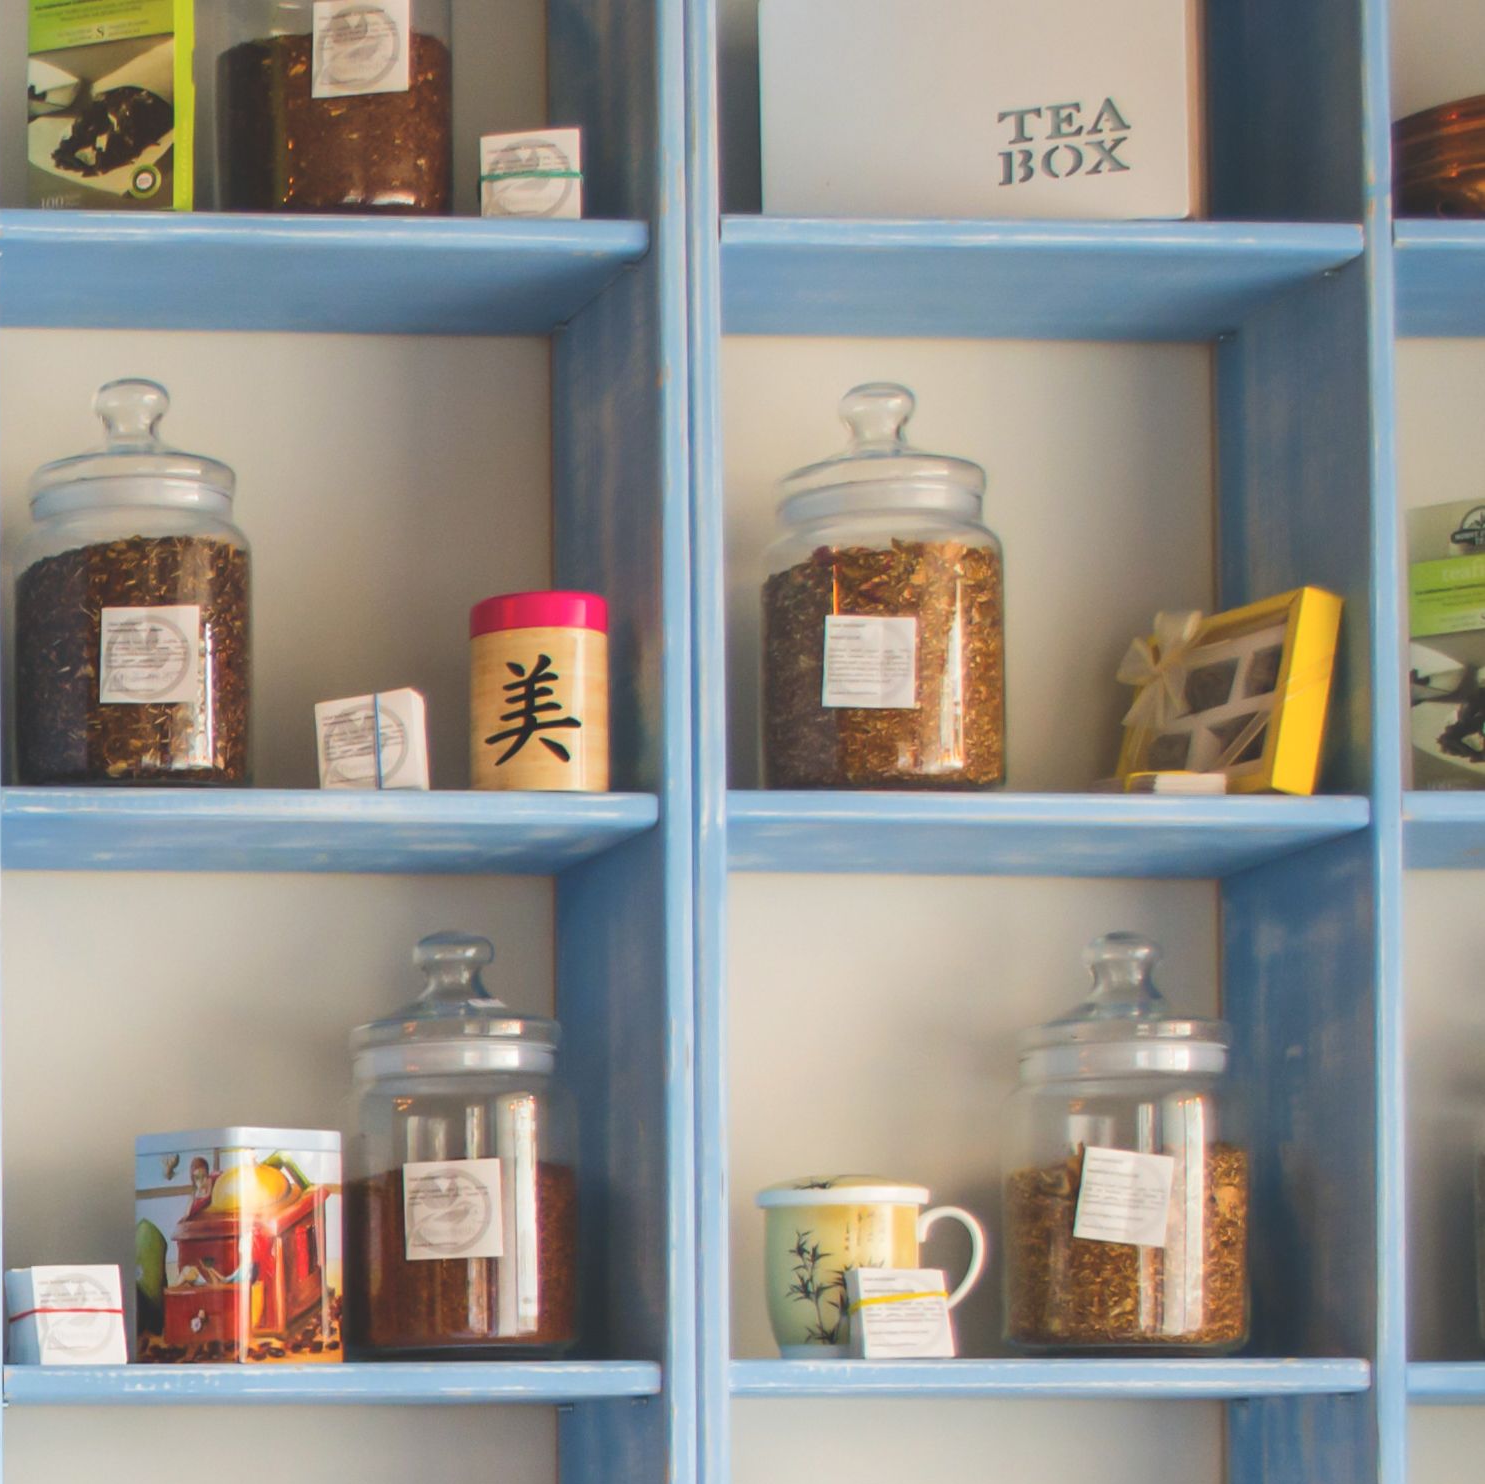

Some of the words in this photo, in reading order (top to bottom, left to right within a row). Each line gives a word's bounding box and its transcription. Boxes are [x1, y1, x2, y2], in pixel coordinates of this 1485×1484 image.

[997, 96, 1132, 145] TEA
[997, 136, 1131, 187] BOX
[484, 653, 583, 767] 美
